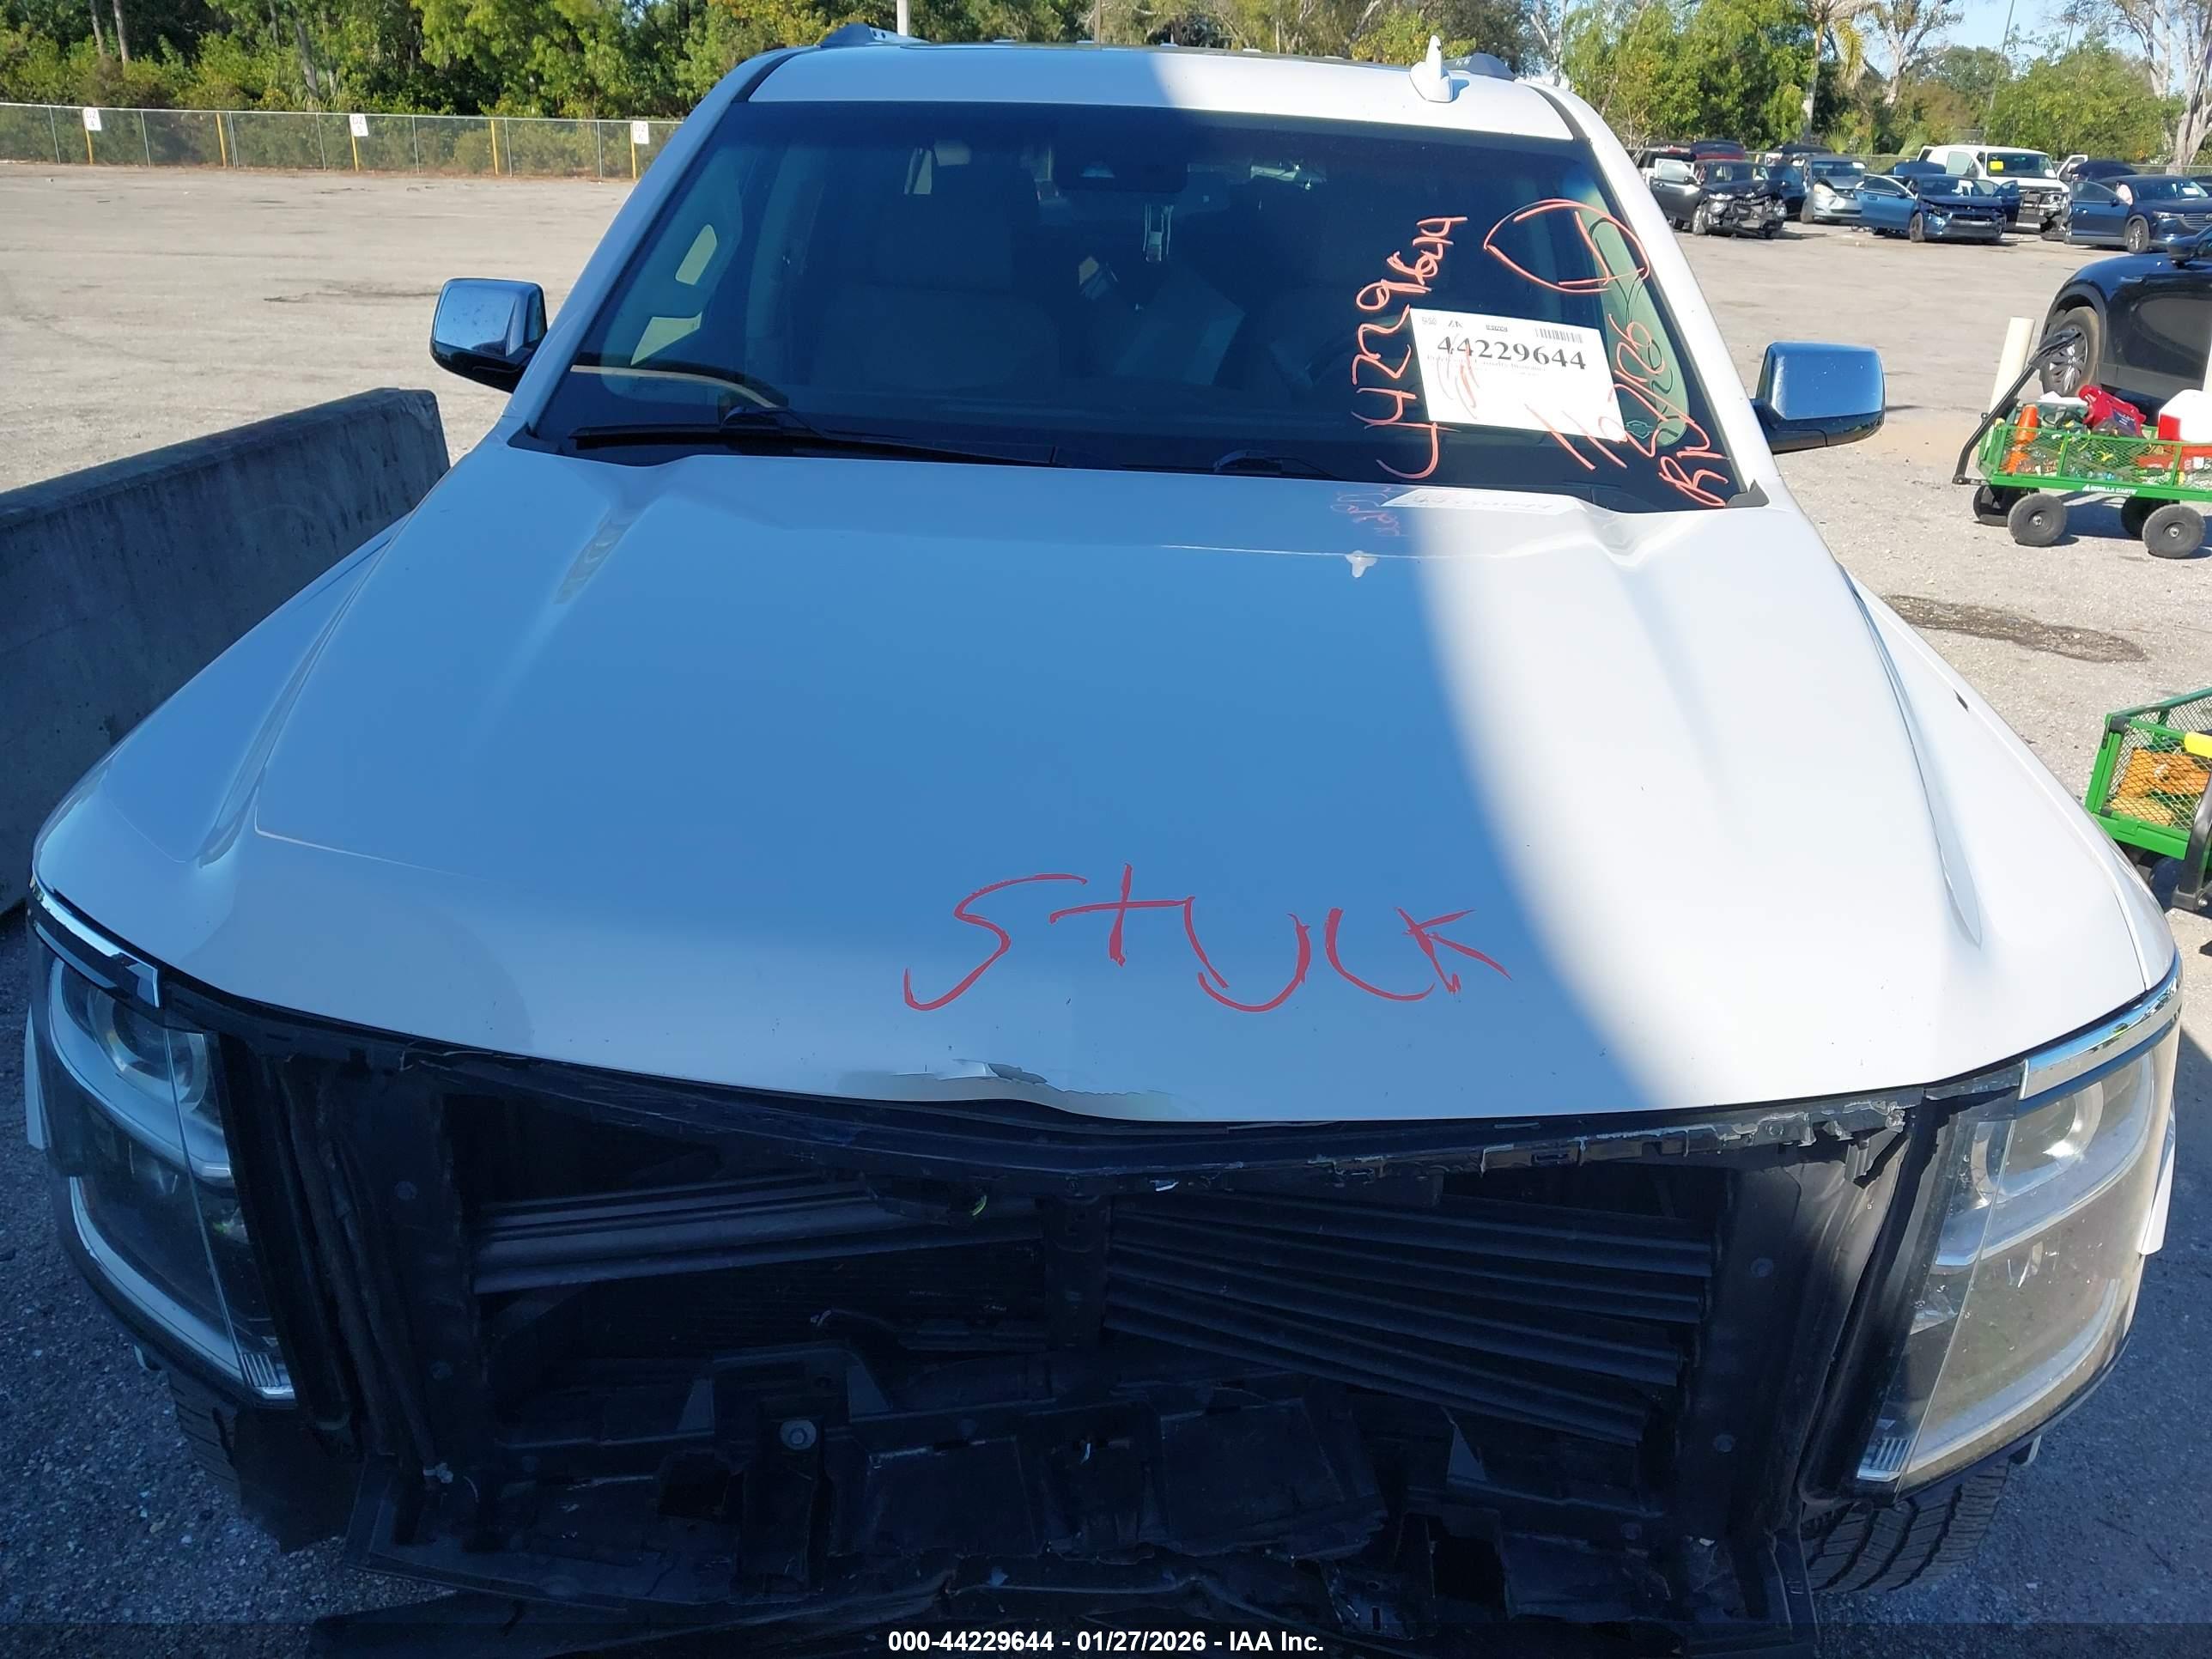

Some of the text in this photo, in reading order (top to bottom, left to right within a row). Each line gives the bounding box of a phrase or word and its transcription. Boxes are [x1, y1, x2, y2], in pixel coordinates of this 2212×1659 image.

[352, 116, 365, 125] DZ
[1351, 216, 1468, 479] 44229644
[1437, 335, 1587, 370] 44229644
[902, 861, 1512, 1012] STUCK
